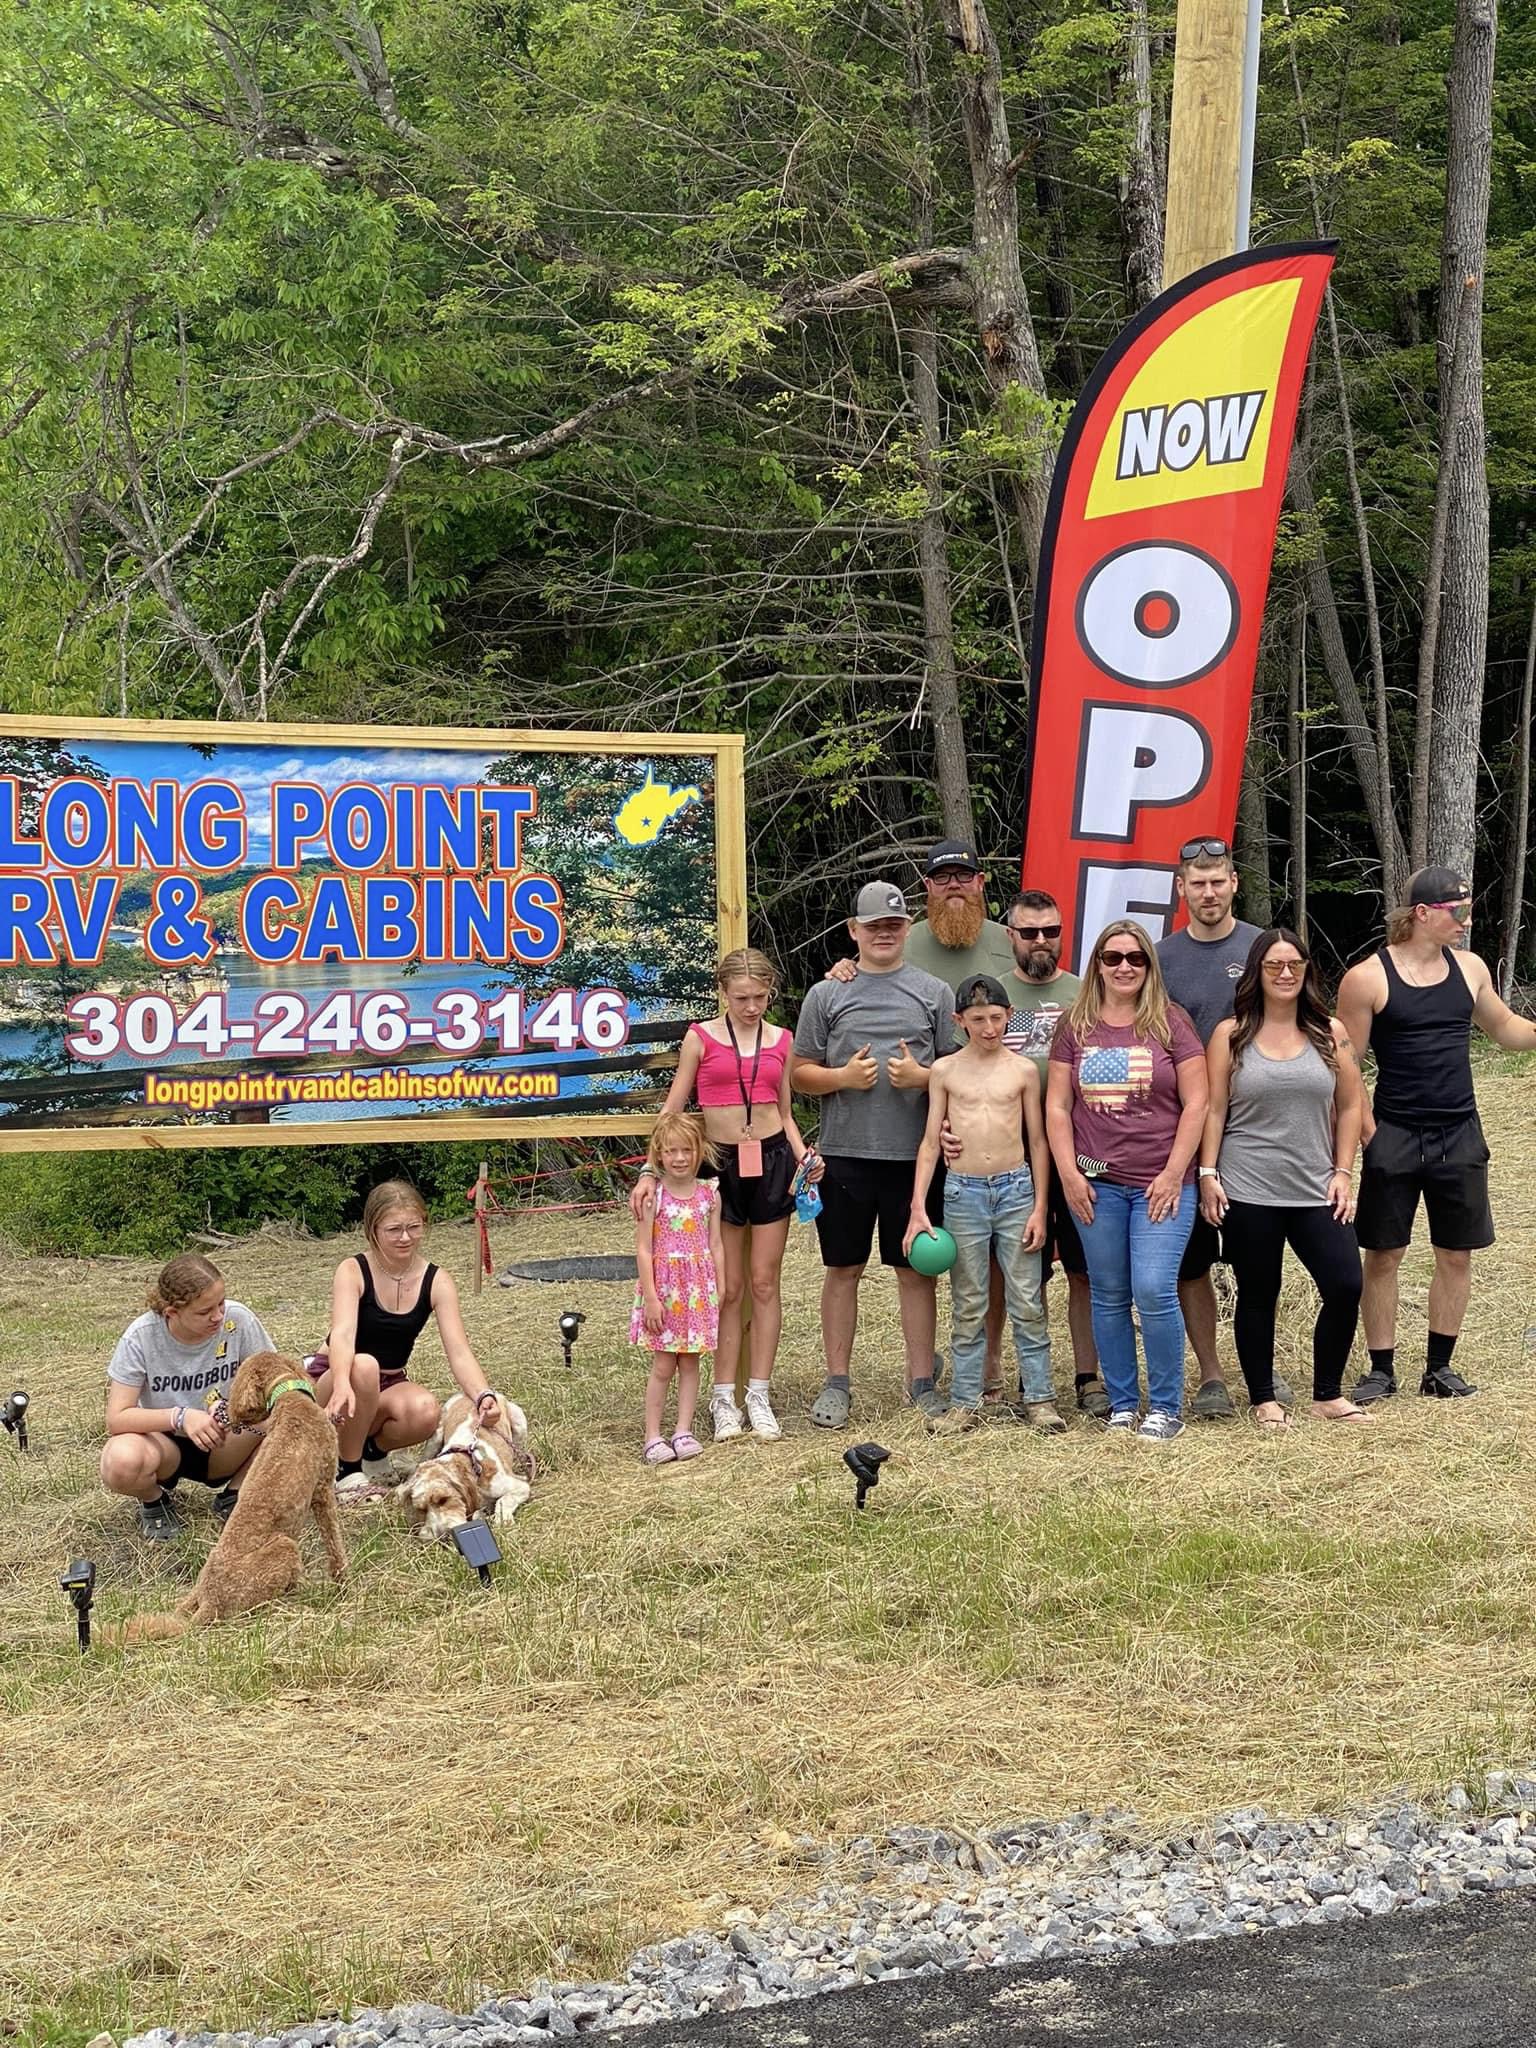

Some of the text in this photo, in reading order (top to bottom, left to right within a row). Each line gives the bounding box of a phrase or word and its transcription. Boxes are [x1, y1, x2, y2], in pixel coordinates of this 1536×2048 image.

[1115, 389, 1267, 480] NOW
[1070, 539, 1240, 978] OPE
[0, 776, 538, 874] LONG POINT
[0, 871, 566, 967] RV & CABINS
[67, 988, 629, 1059] 304-246-3146
[145, 1069, 558, 1110] longpointrvandcabinsofwv.com
